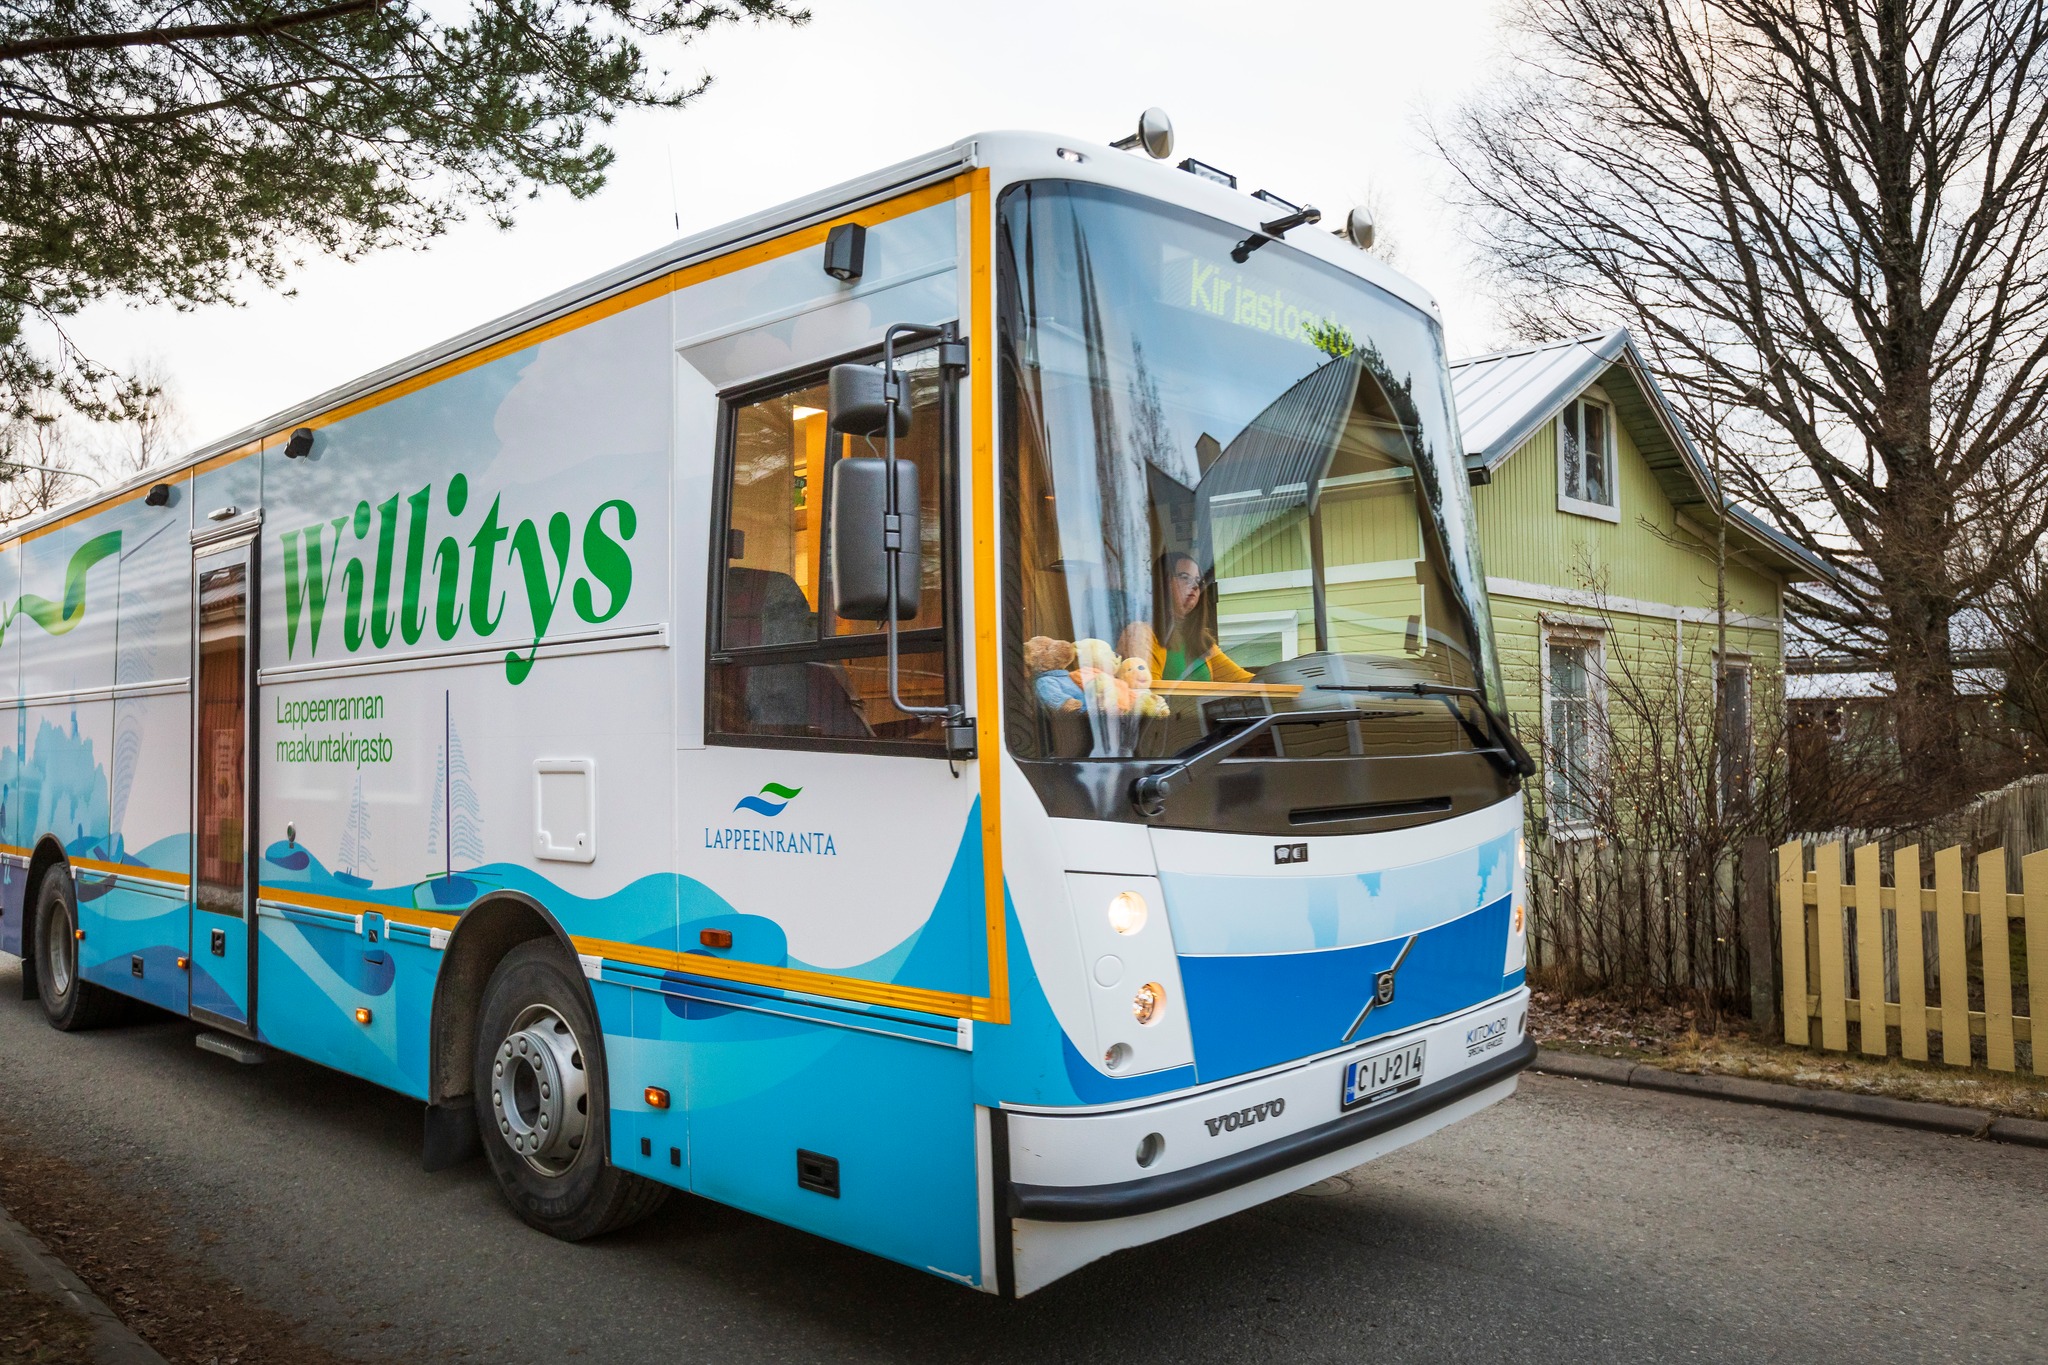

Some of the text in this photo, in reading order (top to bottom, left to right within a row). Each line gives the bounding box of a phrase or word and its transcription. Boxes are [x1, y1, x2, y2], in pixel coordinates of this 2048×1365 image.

[280, 473, 637, 686] Willitys
[276, 695, 384, 731] Lappeenrannan
[276, 731, 393, 771] maakuntakirjasto
[704, 827, 837, 856] LAPPEENRANTA
[1358, 1047, 1422, 1092] CIJ-214
[1204, 1097, 1286, 1138] VOLVO
